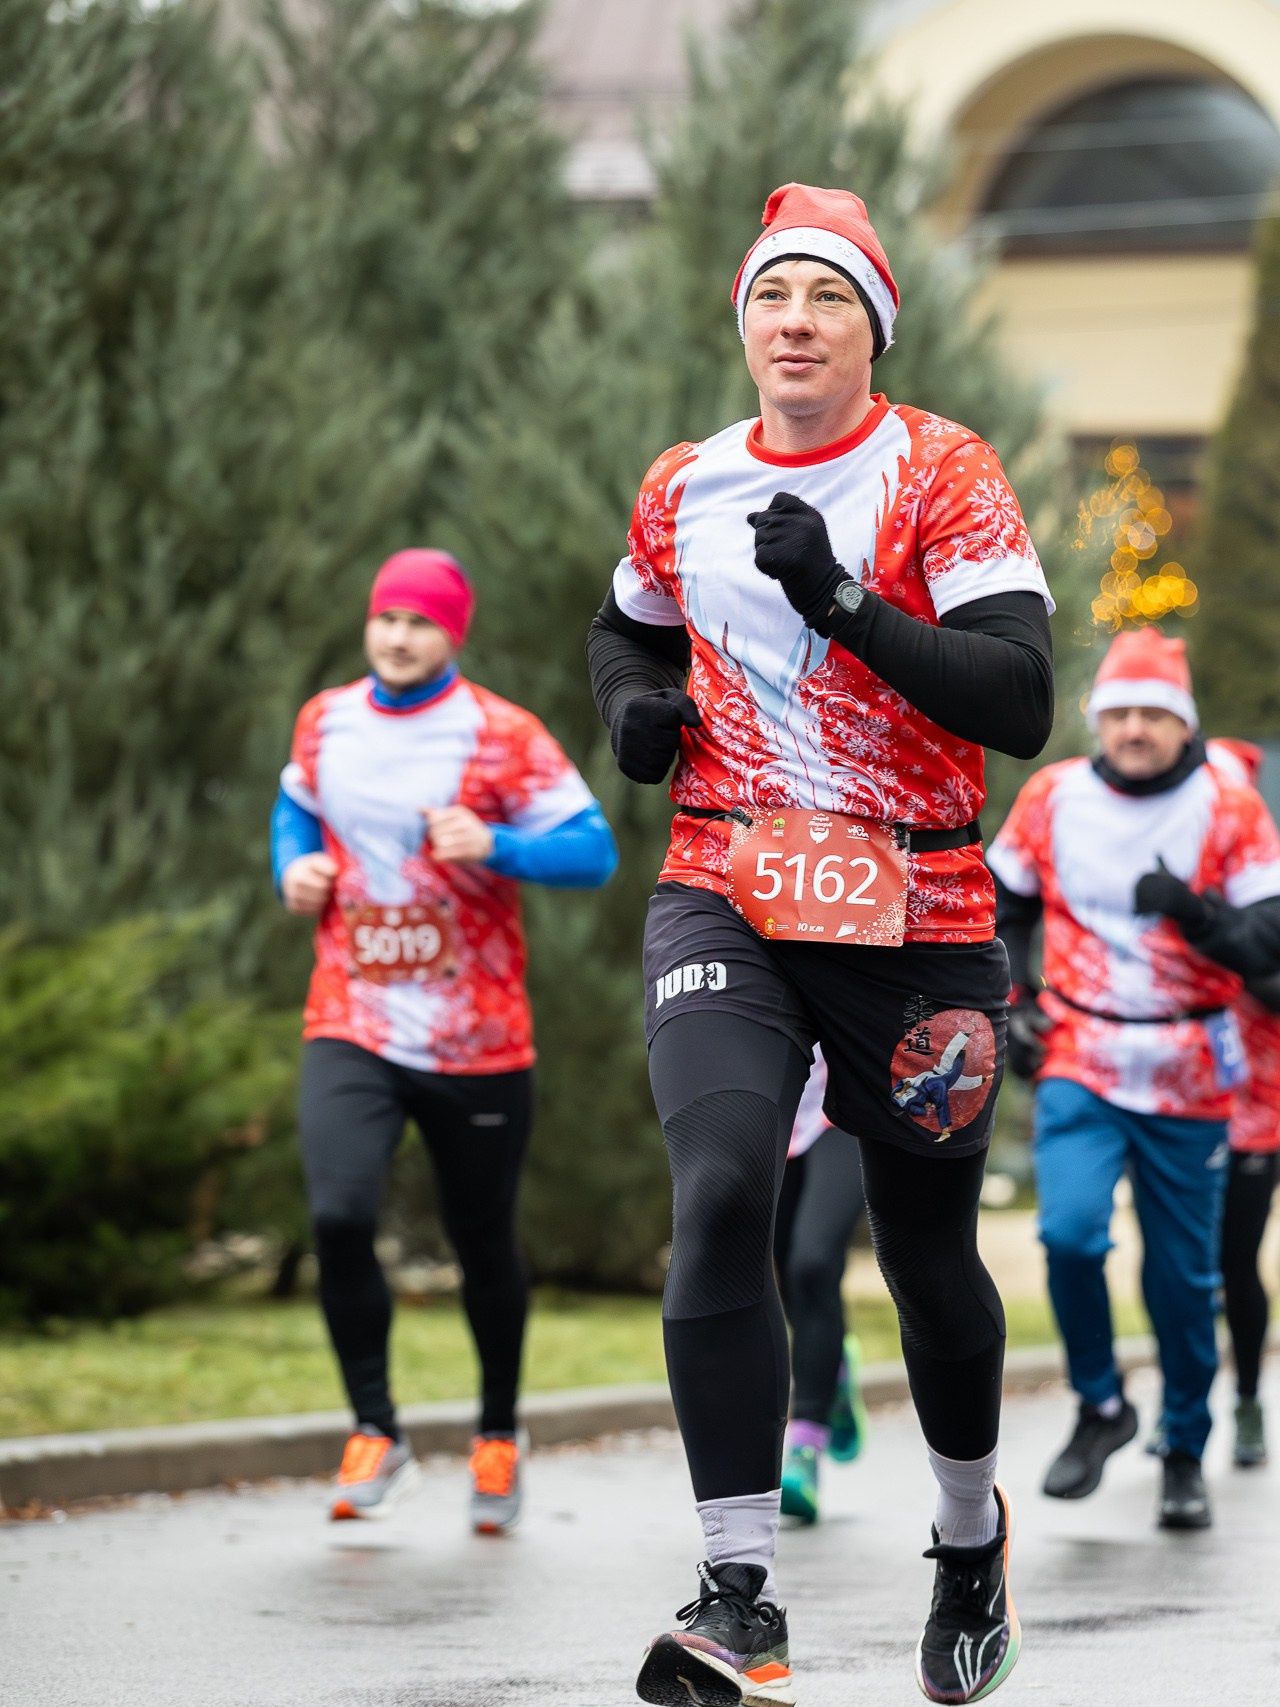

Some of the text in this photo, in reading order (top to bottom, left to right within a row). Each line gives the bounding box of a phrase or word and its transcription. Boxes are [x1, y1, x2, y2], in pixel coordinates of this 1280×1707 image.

[752, 852, 878, 906] 5162
[354, 924, 441, 965] 5019
[797, 922, 808, 932] 10
[655, 962, 727, 1010] JUDO
[903, 994, 935, 1056] 柔道
